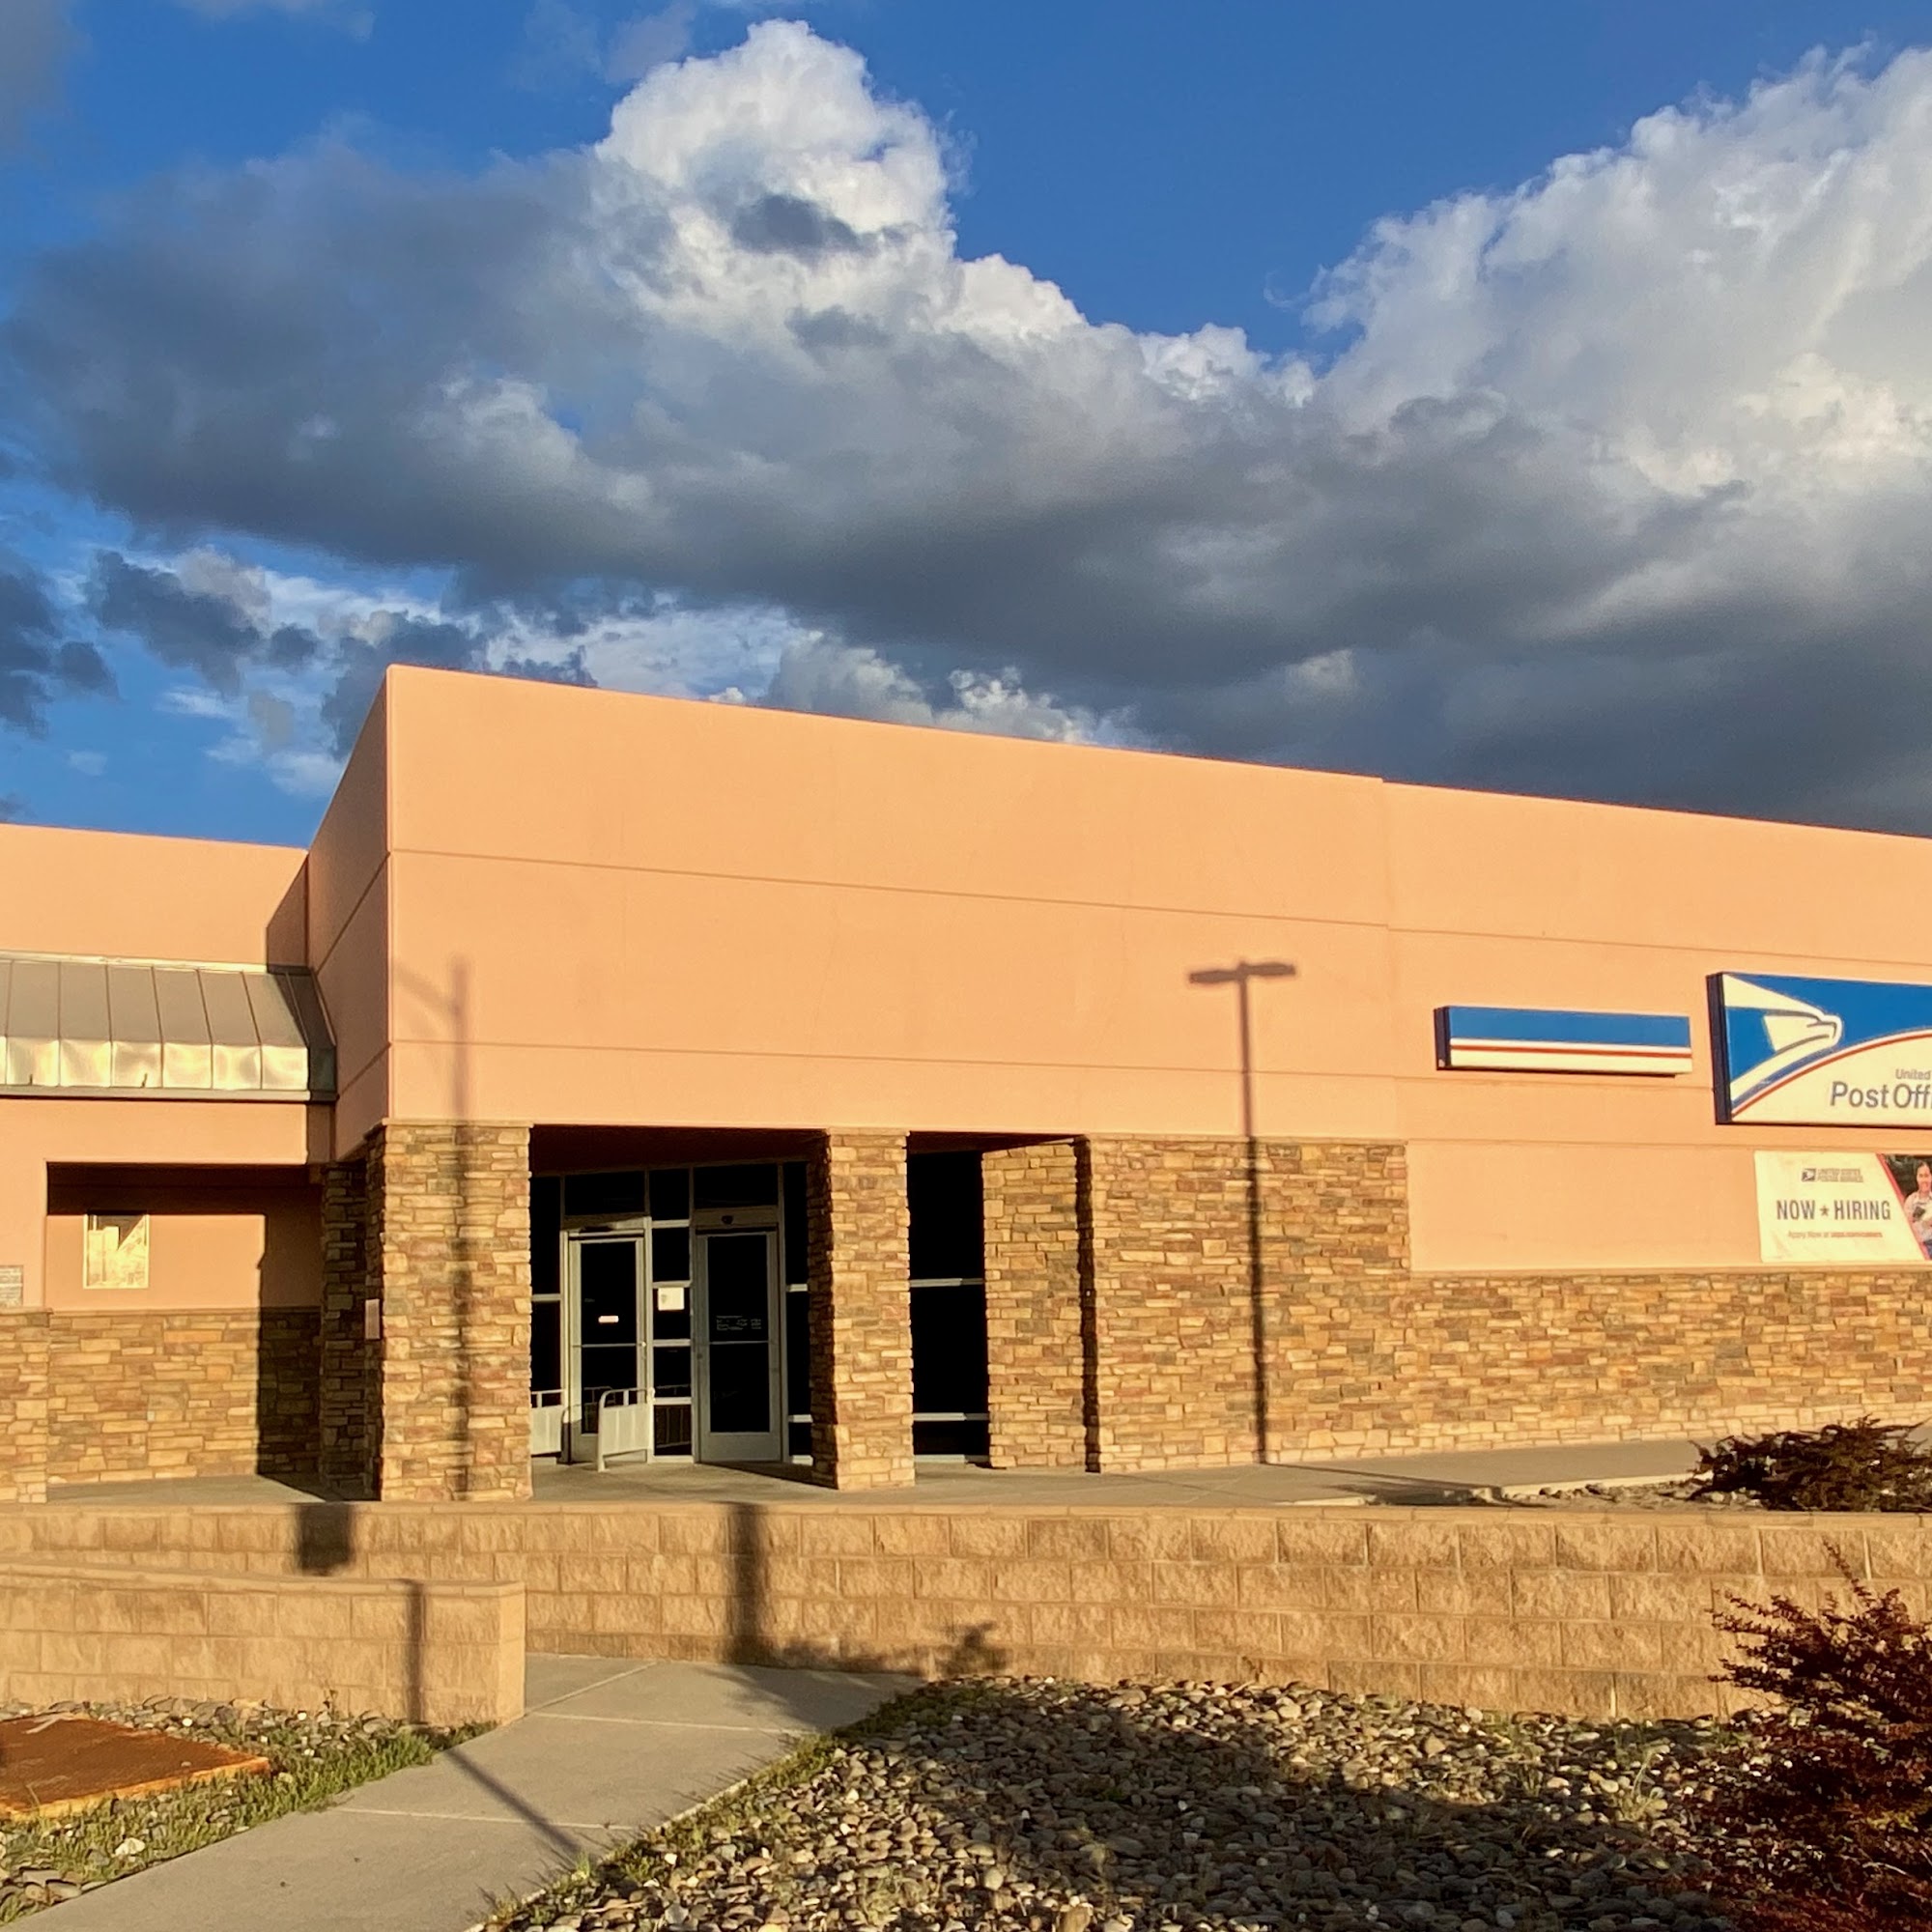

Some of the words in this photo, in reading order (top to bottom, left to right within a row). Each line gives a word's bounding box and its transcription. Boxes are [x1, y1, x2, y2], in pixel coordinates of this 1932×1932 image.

[1895, 1068, 1931, 1080] United
[1831, 1081, 1889, 1109] Post
[1776, 1200, 1815, 1220] NOW
[1833, 1200, 1890, 1220] HIRING
